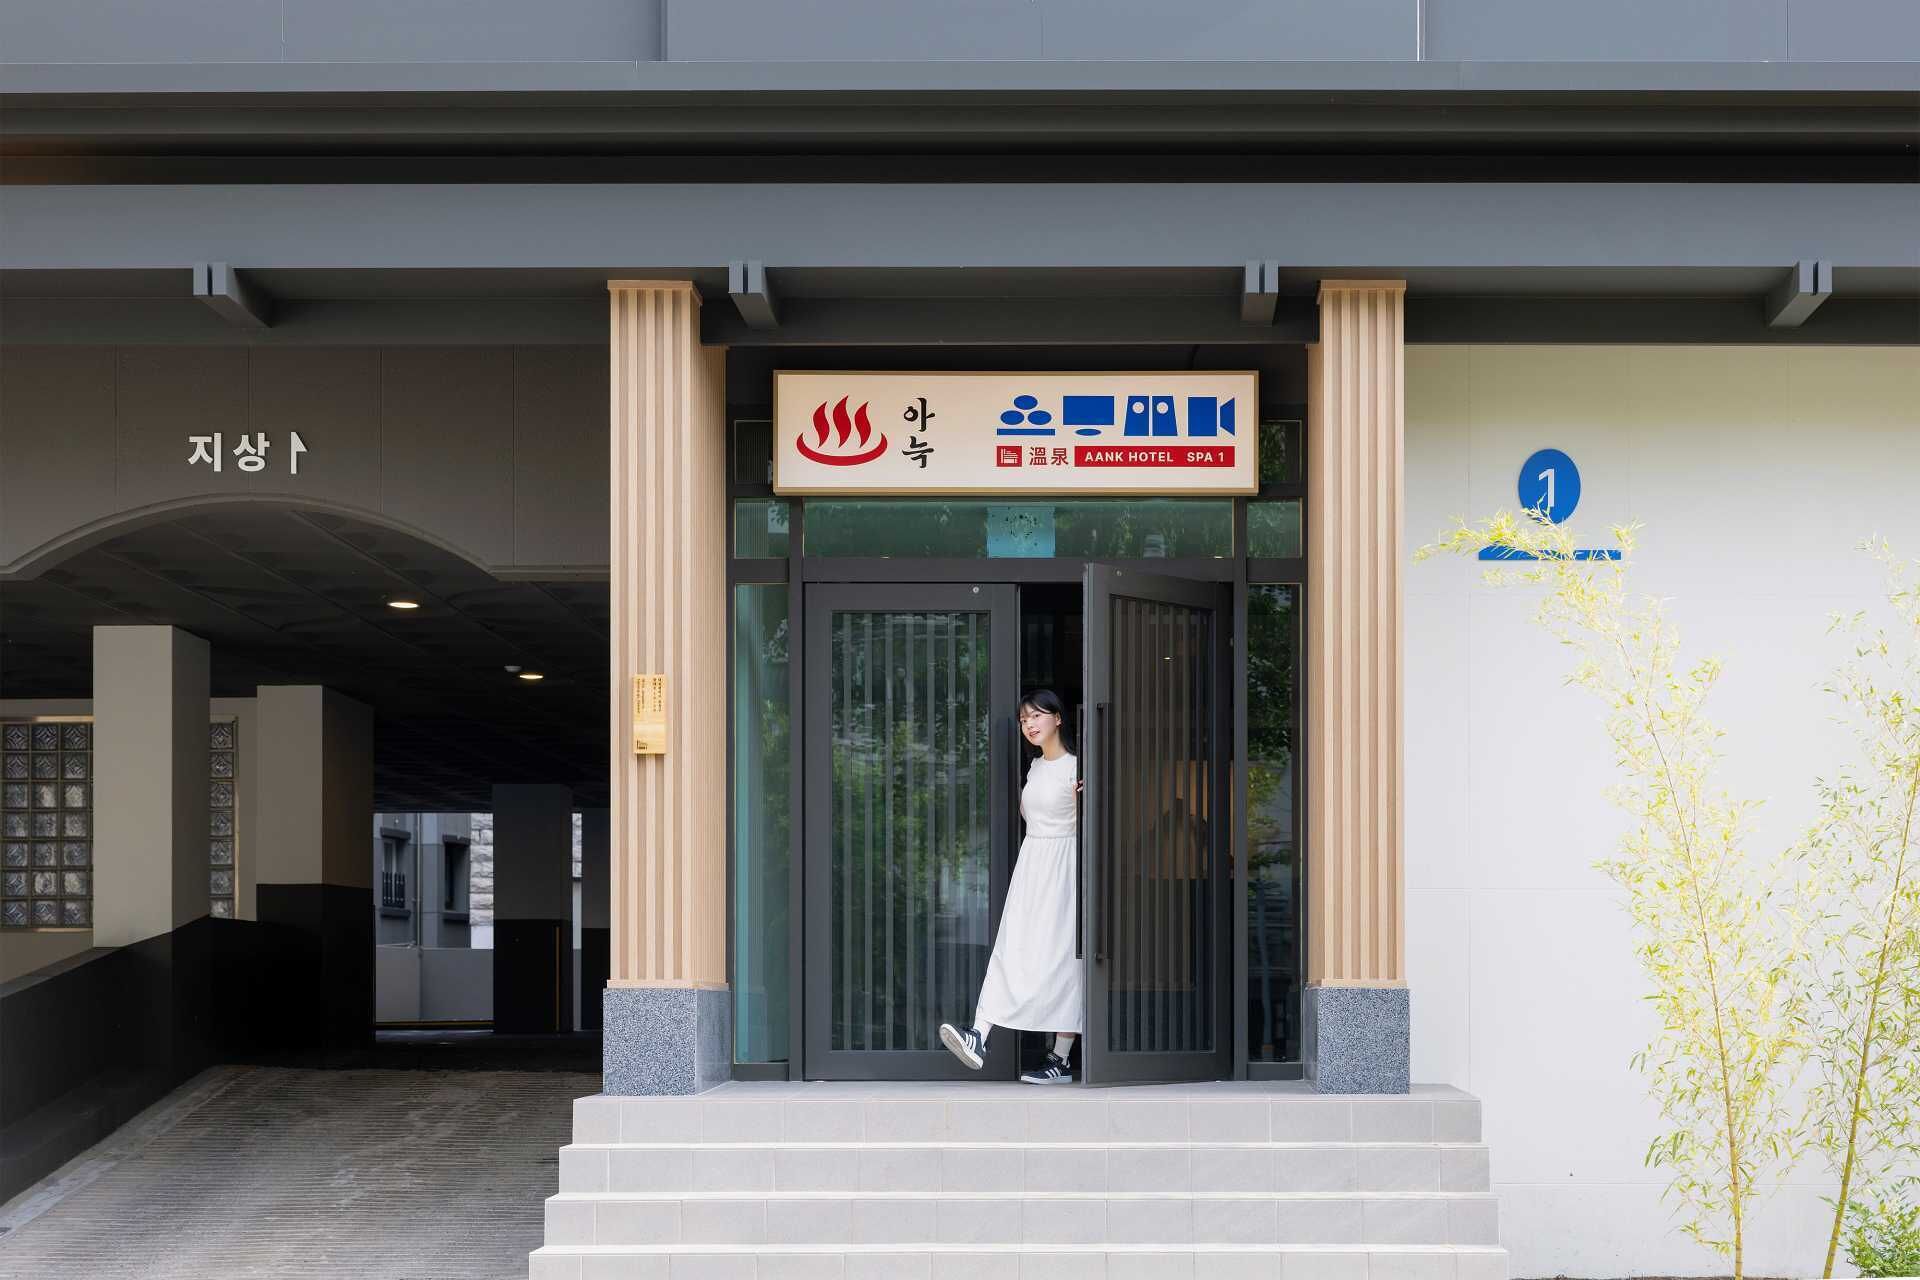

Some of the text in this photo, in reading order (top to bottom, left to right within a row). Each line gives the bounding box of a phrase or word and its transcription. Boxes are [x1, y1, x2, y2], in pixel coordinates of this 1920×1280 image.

[187, 432, 271, 473] 지상
[902, 397, 936, 469] 아늑
[1028, 446, 1069, 466] 溫泉
[1084, 451, 1225, 463] AANK HOTEL SPA 1
[1538, 468, 1555, 508] 1
